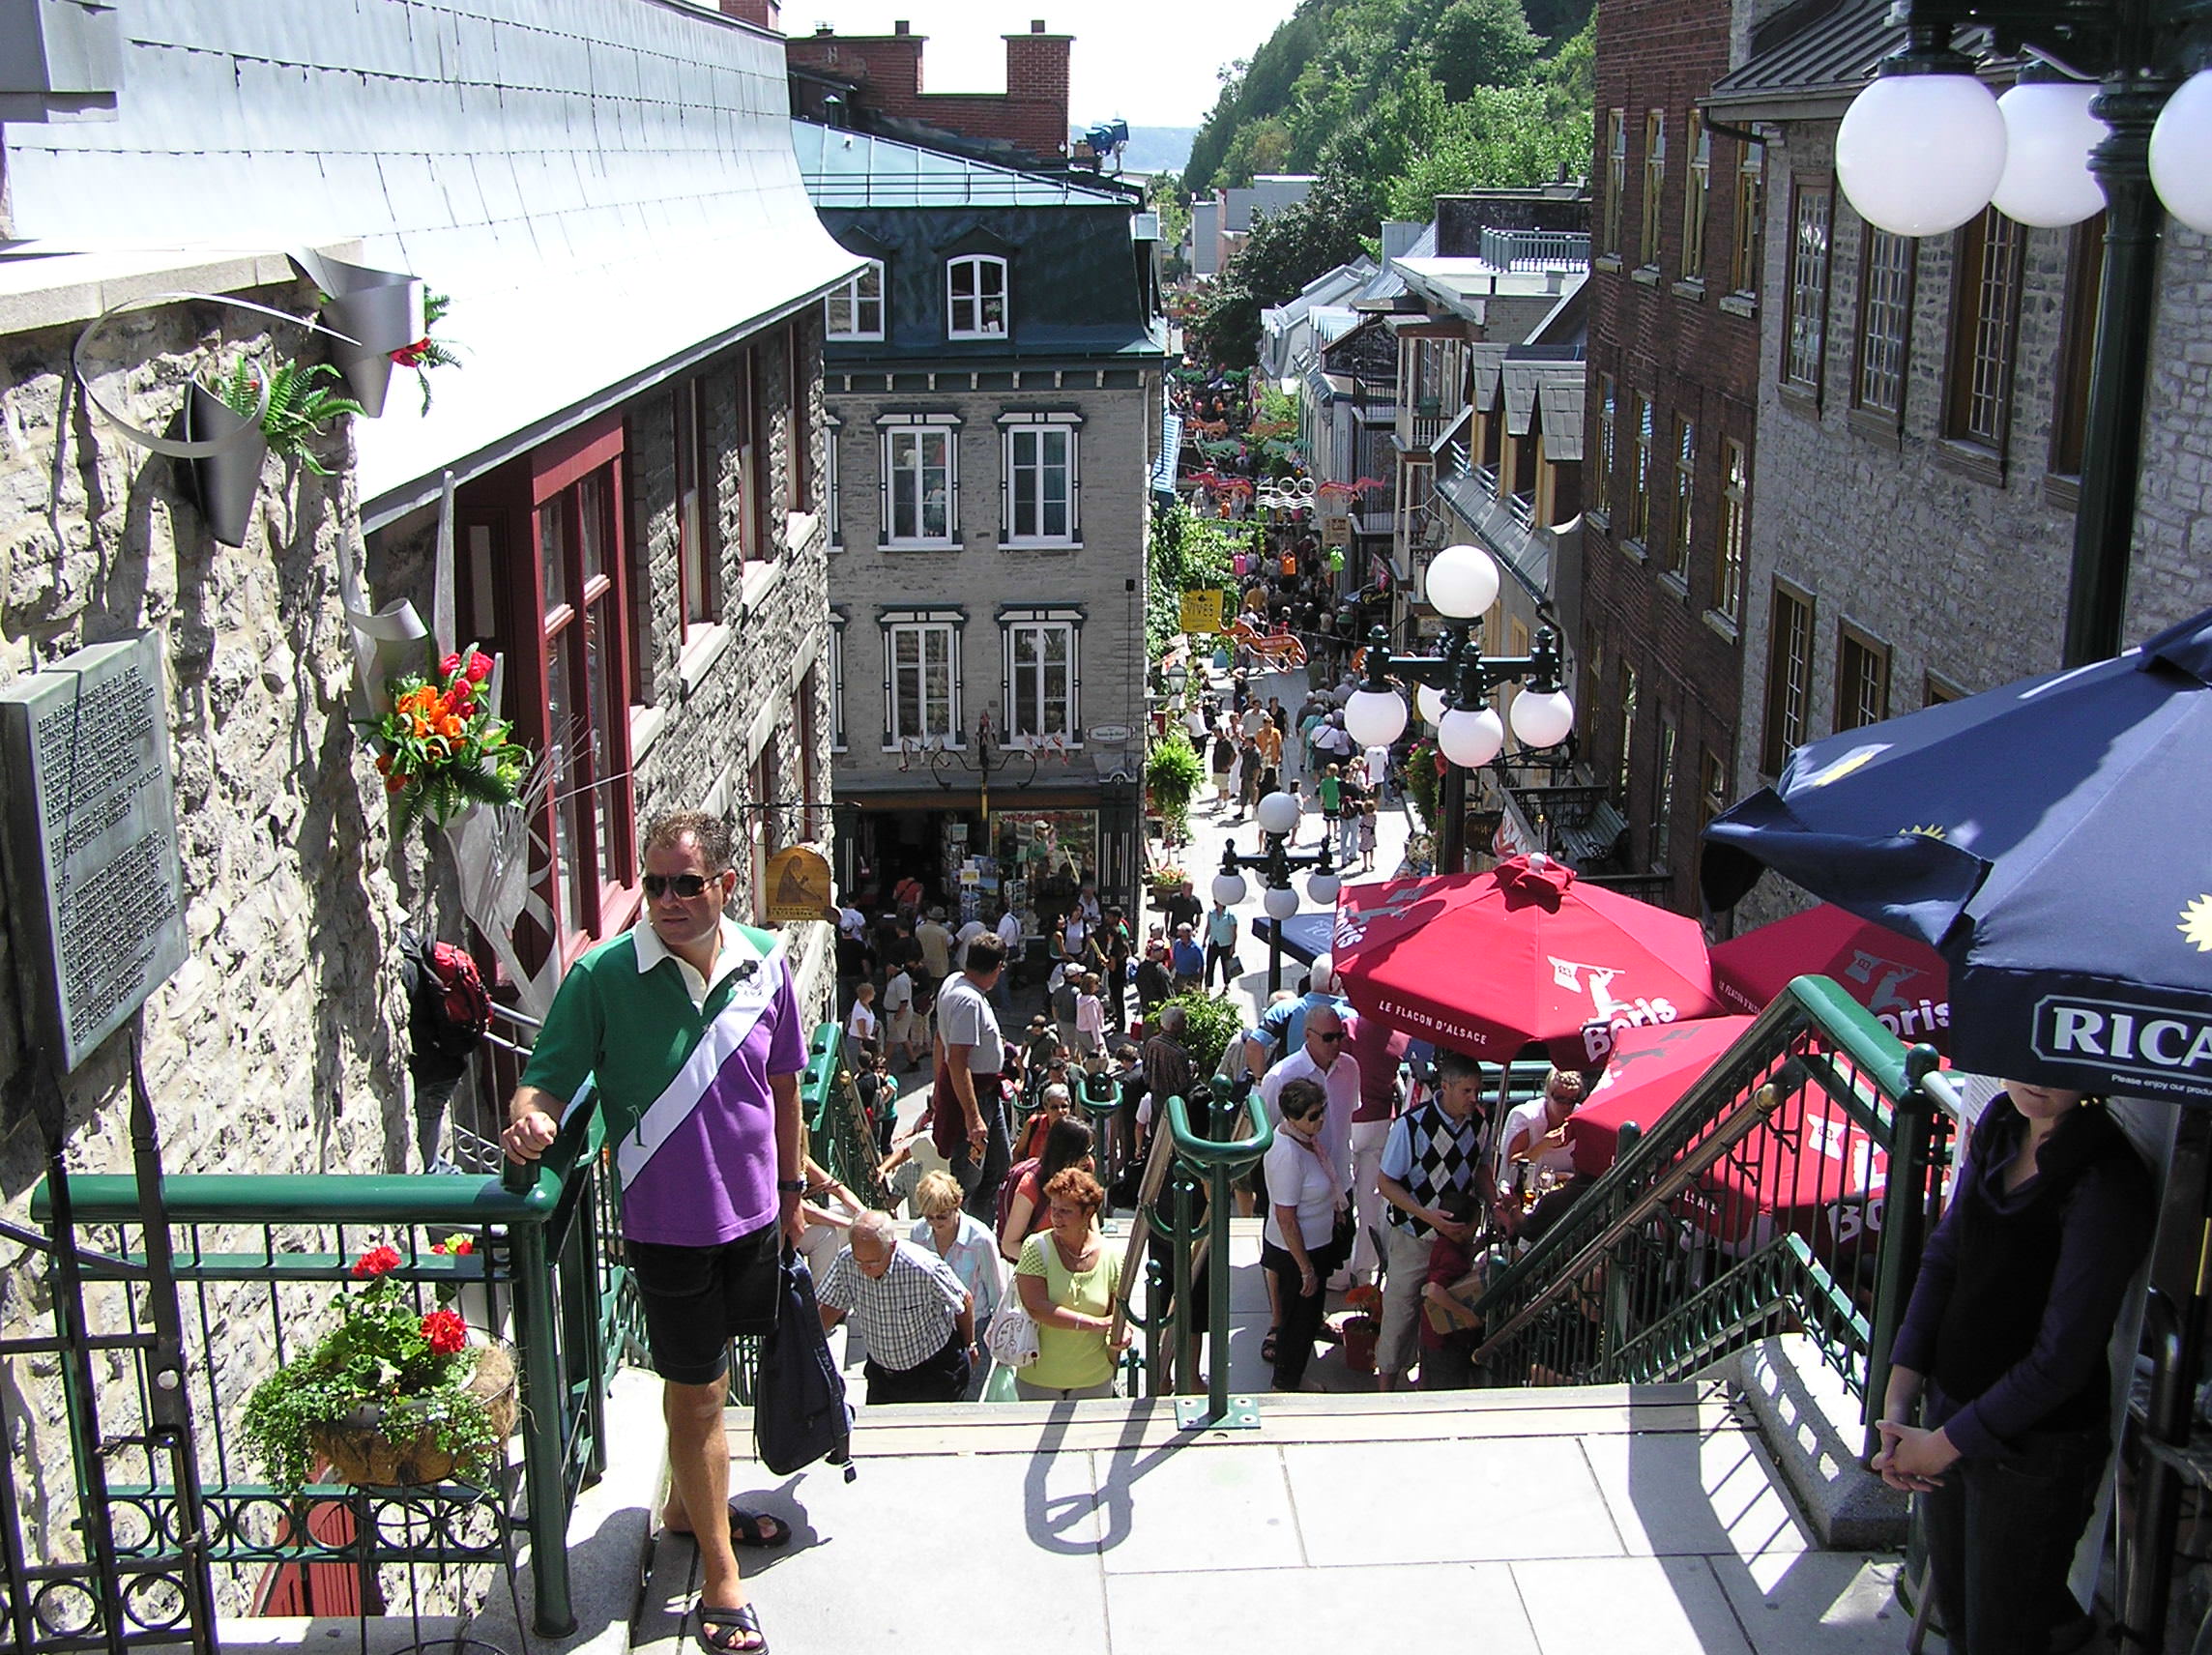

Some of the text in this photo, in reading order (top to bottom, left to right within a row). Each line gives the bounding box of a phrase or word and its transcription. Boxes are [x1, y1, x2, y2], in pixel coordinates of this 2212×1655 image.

[1257, 477, 1316, 496] 400
[1337, 905, 1367, 948] oris
[1379, 1000, 1487, 1045] LE FLACON D'ALSACE
[1583, 997, 1677, 1063] Boris
[1877, 1000, 1949, 1038] oris
[2111, 1073, 2142, 1087] Please
[2143, 1080, 2168, 1090] enjoy
[2169, 1084, 2187, 1092] our
